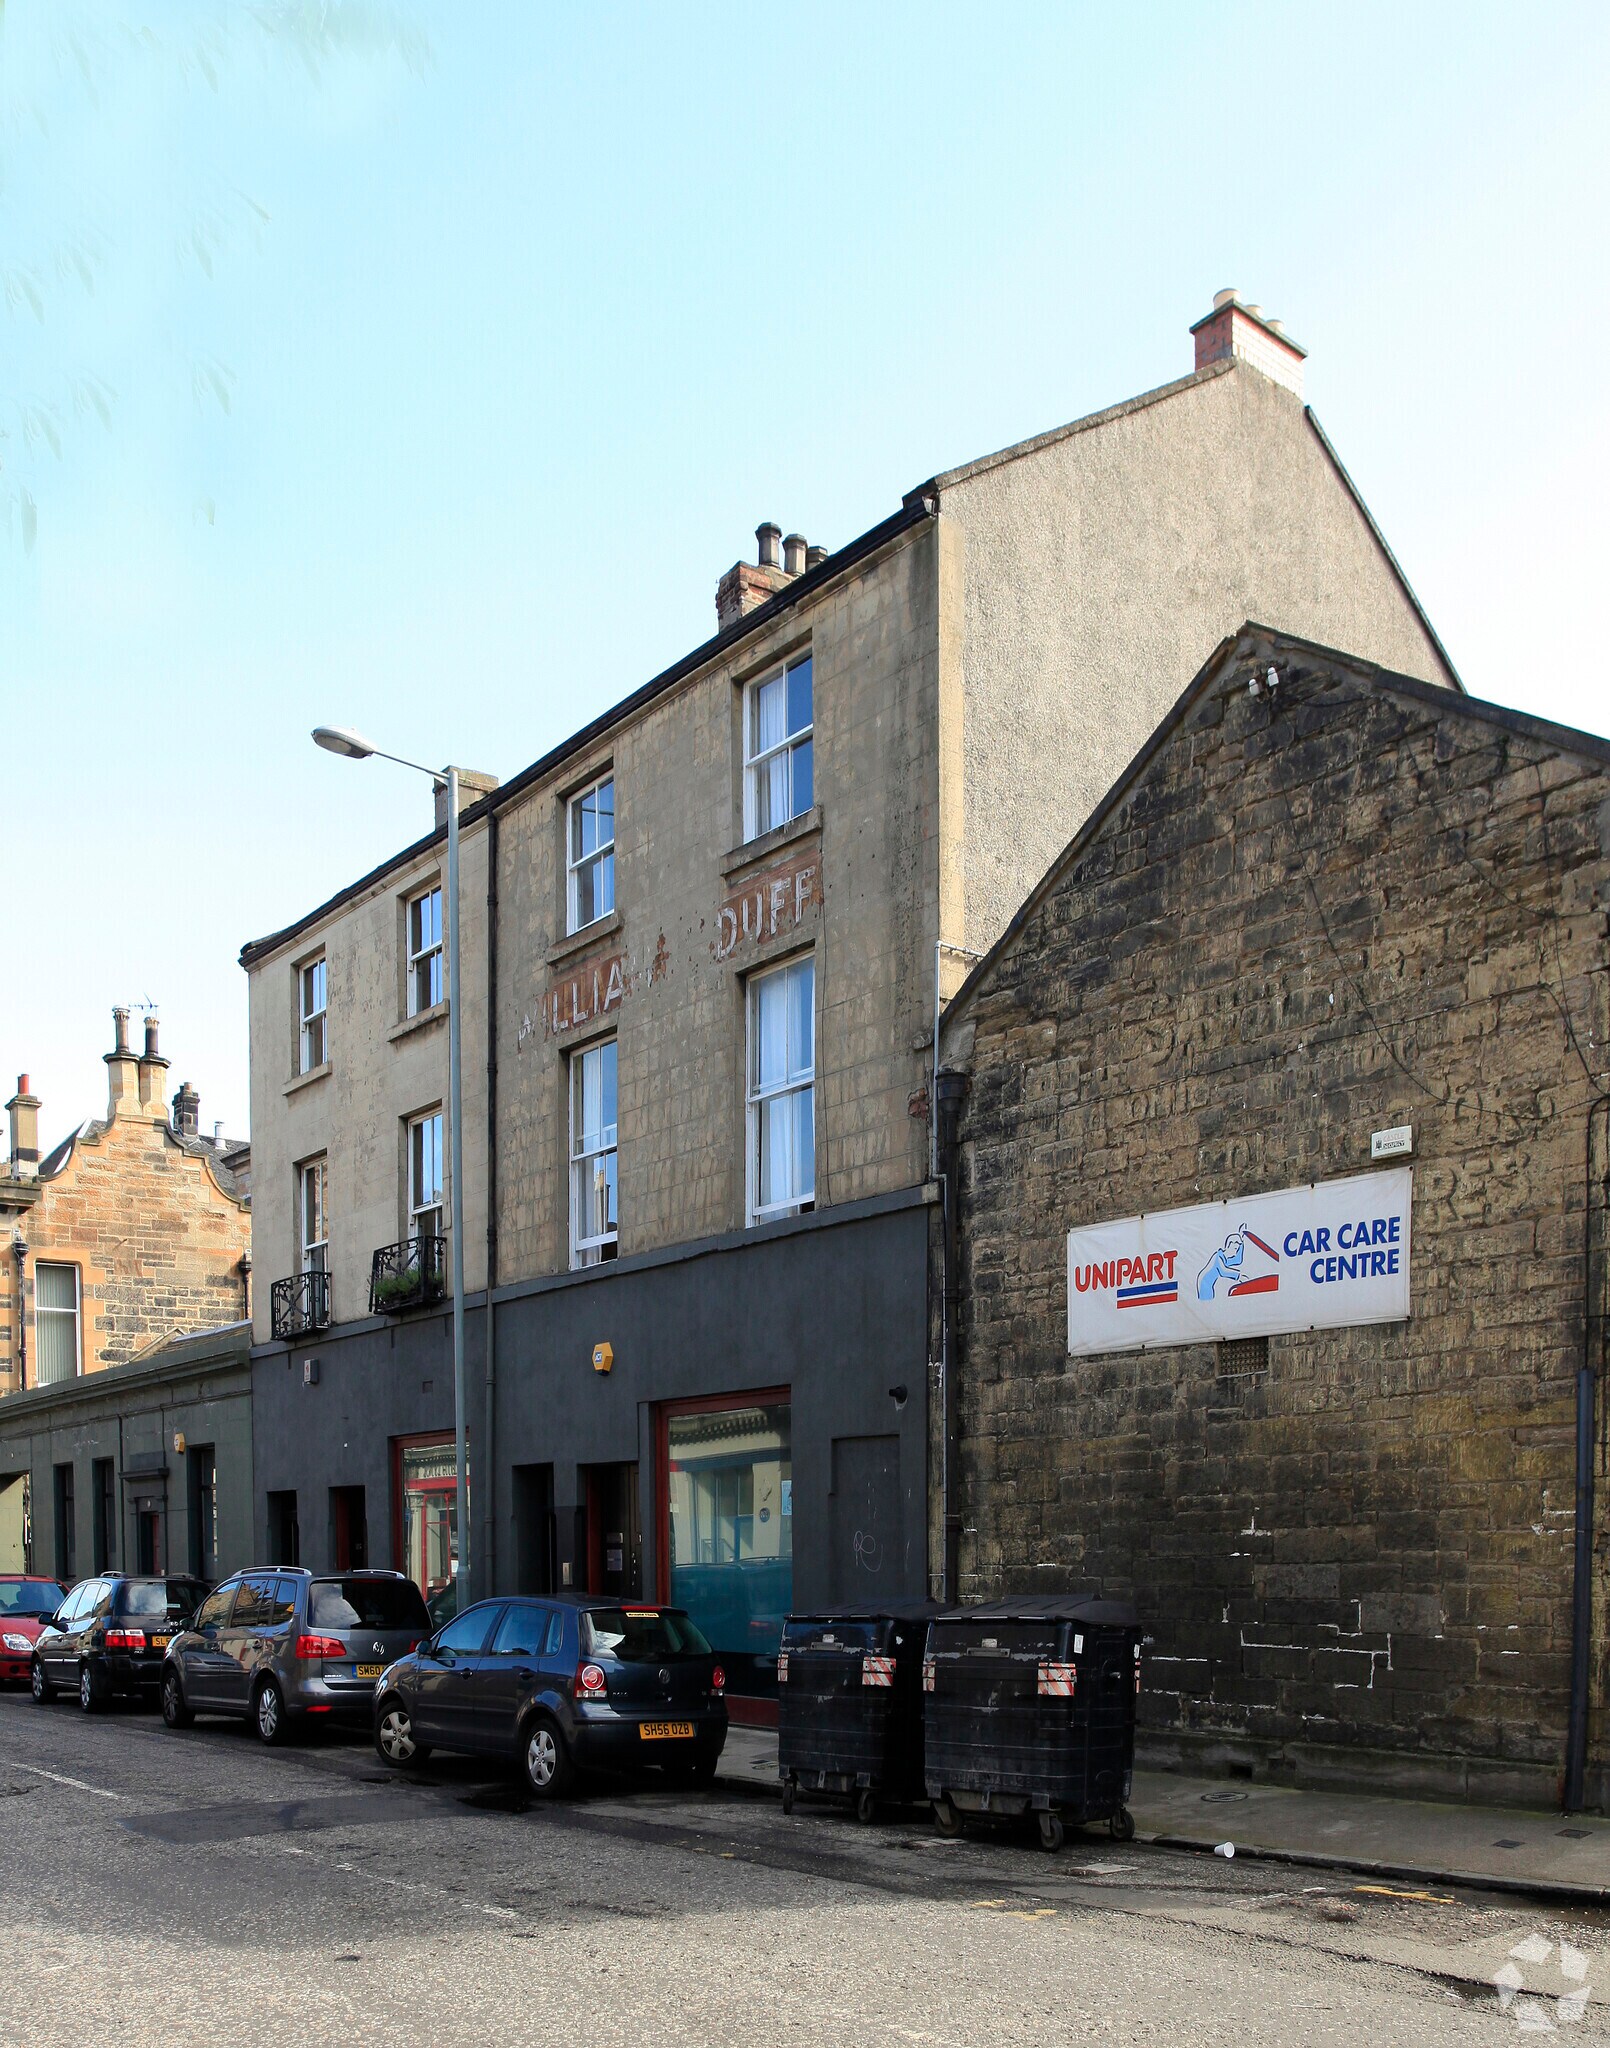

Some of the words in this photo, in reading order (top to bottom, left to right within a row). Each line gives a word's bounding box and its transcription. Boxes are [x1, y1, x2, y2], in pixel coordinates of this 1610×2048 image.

[716, 865, 816, 961] DUFF
[1283, 1226, 1331, 1257] CAR
[1337, 1216, 1401, 1247] CARE
[1075, 1250, 1178, 1292] UNIPART
[1310, 1249, 1400, 1284] CENTRE
[643, 1724, 670, 1736] SH56
